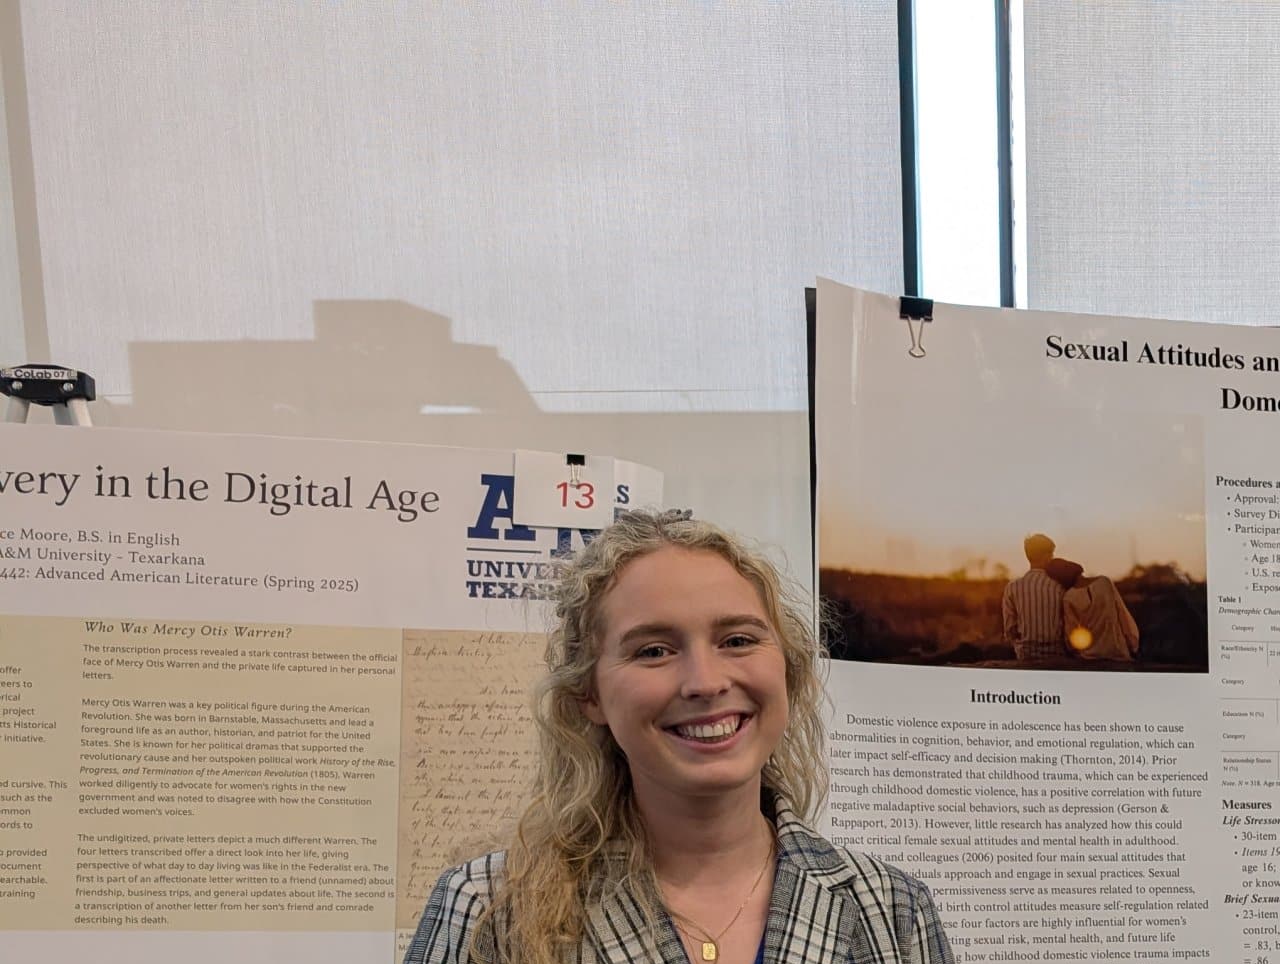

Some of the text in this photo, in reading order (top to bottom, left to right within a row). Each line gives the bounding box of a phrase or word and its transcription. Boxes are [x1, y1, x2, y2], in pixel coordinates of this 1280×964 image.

[1045, 335, 1128, 363] Sexual
[1137, 342, 1245, 370] Attitudes
[1215, 475, 1273, 489] Procedures
[94, 464, 132, 498] in
[145, 465, 209, 502] the
[224, 472, 353, 517] Digital
[366, 479, 440, 523] Age
[556, 482, 595, 509] 13
[20, 527, 72, 543] Moore,
[108, 530, 122, 545] in
[127, 532, 180, 549] English
[37, 547, 112, 566] University
[128, 549, 205, 566] Texarkana
[1250, 553, 1269, 566] Age
[34, 565, 105, 581] Advanced
[109, 568, 181, 584] American
[185, 572, 258, 587] Literature
[263, 574, 315, 593] (Spring
[320, 579, 359, 593] 2025)
[85, 620, 293, 640] Who Was Mercy Otis Warren?
[970, 689, 1061, 705] Introduction
[846, 713, 895, 727] Domestic
[896, 716, 939, 729] violence
[940, 721, 987, 732] exposure
[1001, 719, 1062, 732] adolescence
[1063, 720, 1082, 732] has
[1083, 721, 1107, 732] been
[1109, 721, 1142, 733] shown
[1156, 724, 1185, 733] cause
[1222, 799, 1273, 810] Measures
[1222, 815, 1242, 827] Life
